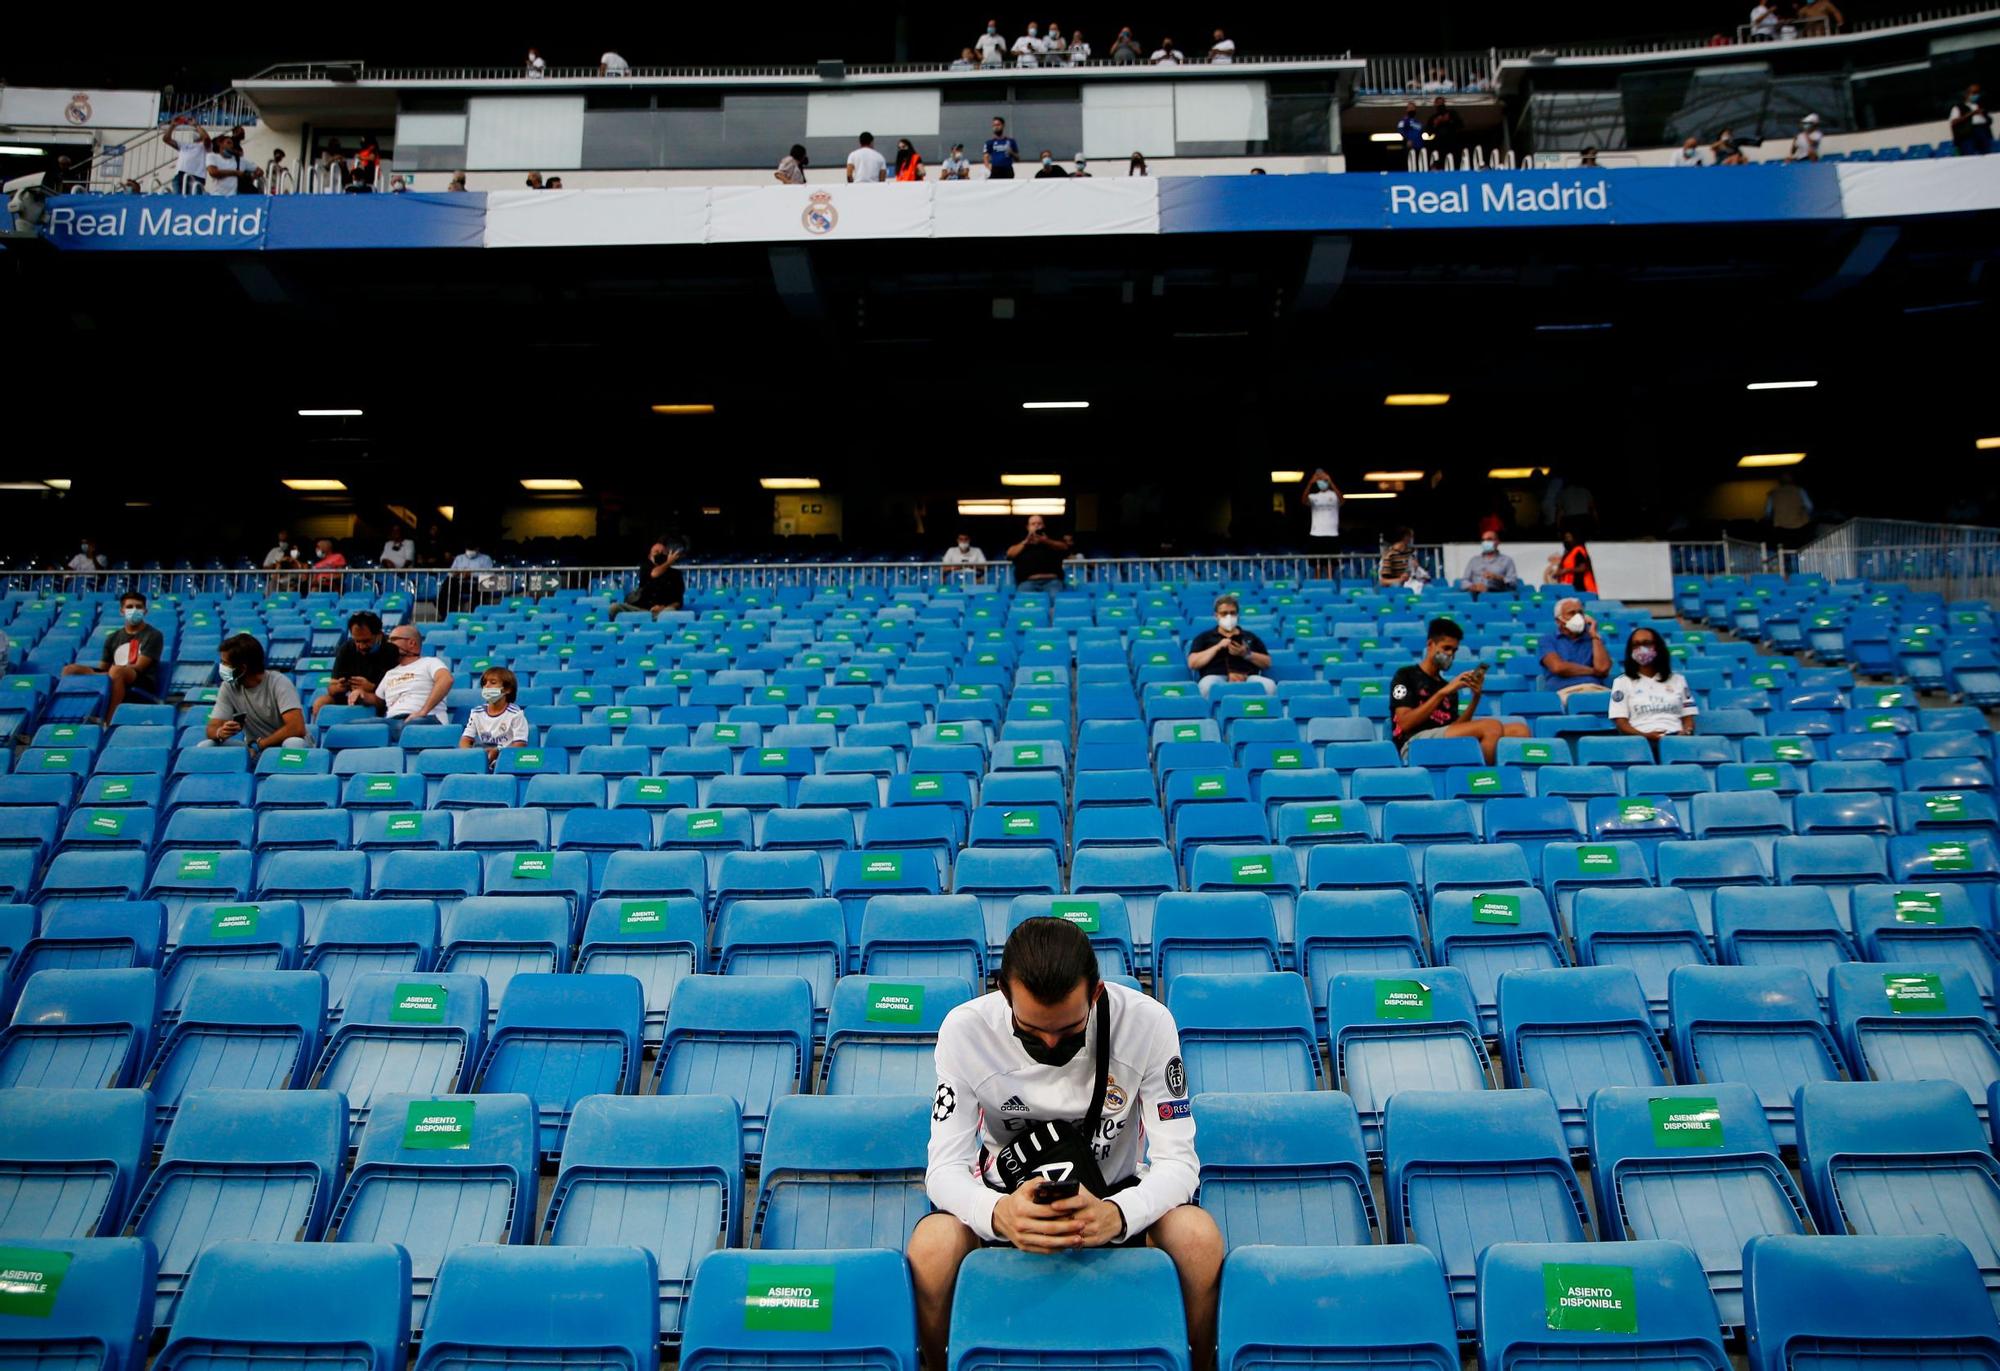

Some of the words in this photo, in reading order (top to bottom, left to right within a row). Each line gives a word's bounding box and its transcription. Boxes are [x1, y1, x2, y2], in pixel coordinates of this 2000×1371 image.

[1391, 184, 1469, 213] Real
[1482, 180, 1607, 211] Madrid
[51, 208, 127, 235] Real
[139, 208, 262, 236] Madrid
[1172, 1076, 1181, 1087] 13
[1174, 1104, 1190, 1114] RES
[1664, 1122, 1710, 1130] DISPONIBLE
[0, 1270, 43, 1281] ASIENTO
[768, 1288, 811, 1297] ASIENTO
[1568, 1288, 1612, 1297] ASIENTO
[760, 1296, 819, 1308] DISPONIBLE
[1560, 1298, 1622, 1308] DISPONIBLE
